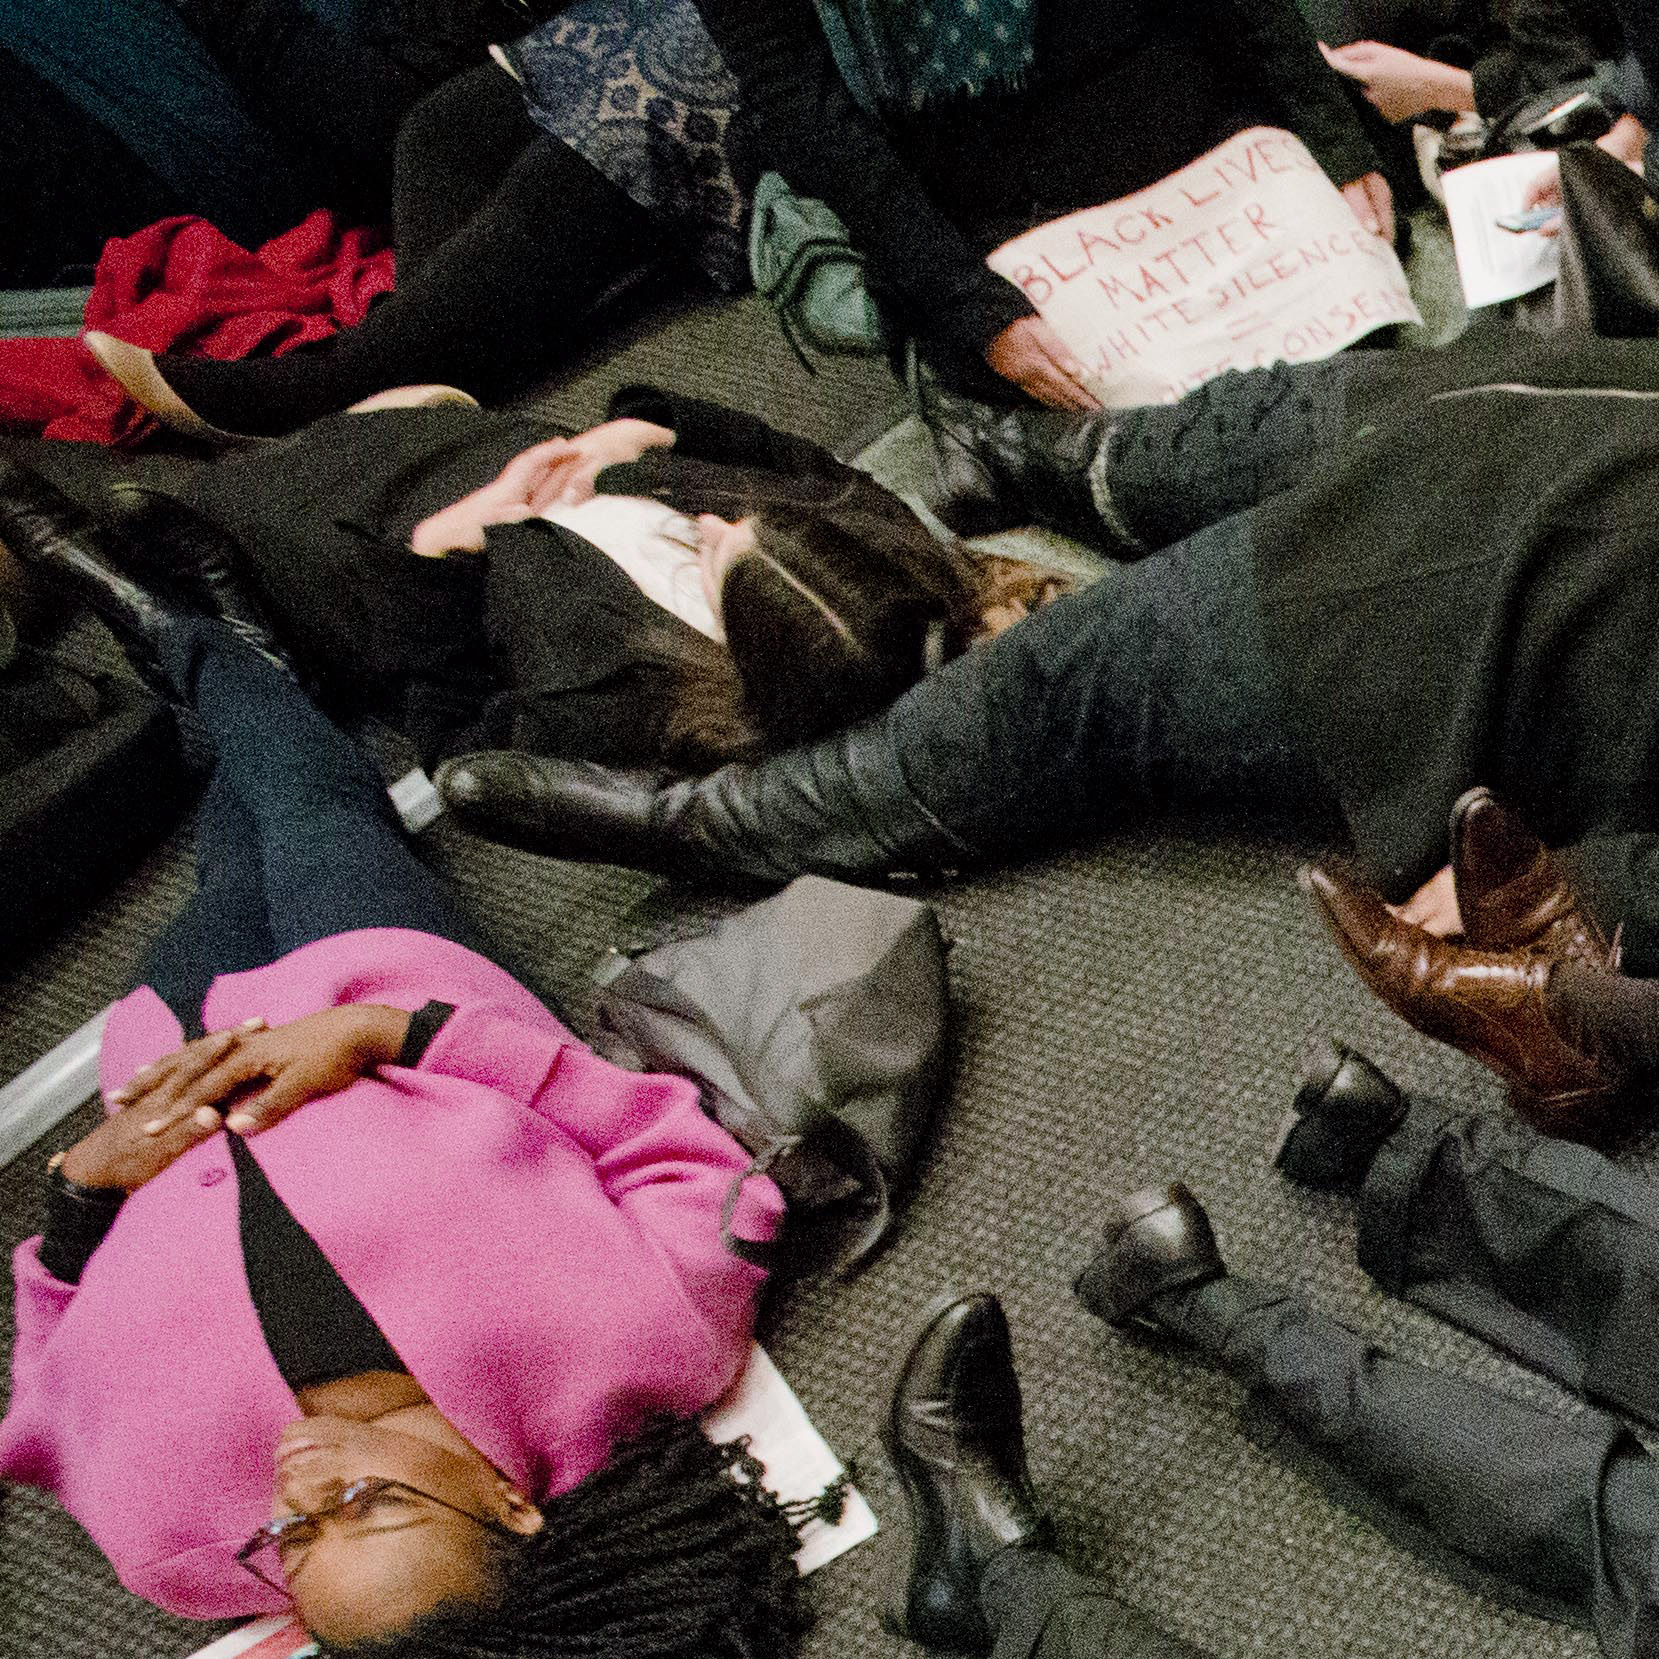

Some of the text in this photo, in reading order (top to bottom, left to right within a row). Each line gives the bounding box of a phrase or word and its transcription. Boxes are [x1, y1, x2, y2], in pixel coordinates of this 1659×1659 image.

[1012, 134, 1320, 305] BLACK LIVES
[1098, 203, 1277, 309] MATTER
[1080, 297, 1197, 383] WHITE
[1208, 229, 1376, 310] SILENCE
